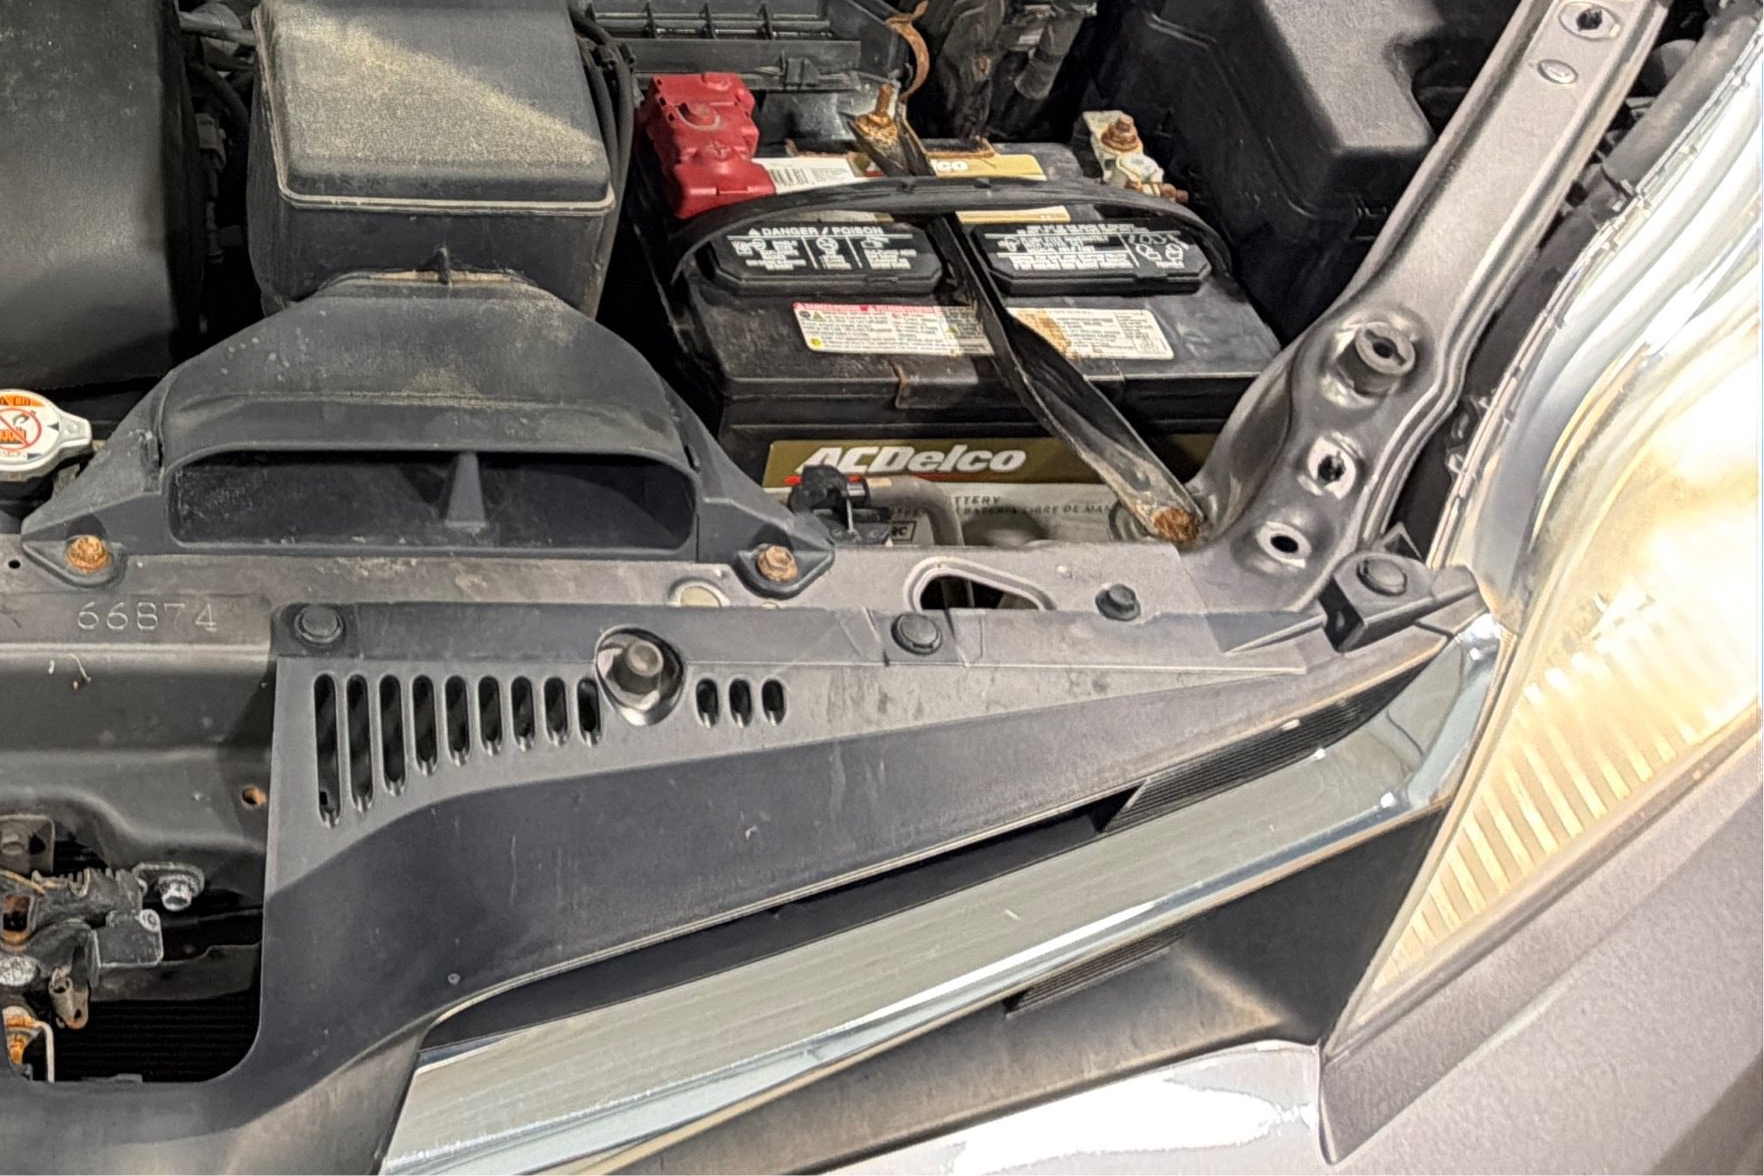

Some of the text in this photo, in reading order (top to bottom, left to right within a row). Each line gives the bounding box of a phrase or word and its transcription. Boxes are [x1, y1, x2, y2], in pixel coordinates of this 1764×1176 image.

[761, 227, 819, 236] DANGER
[832, 226, 884, 235] POISON
[794, 444, 1027, 474] ACDelco
[76, 600, 218, 633] 66874
